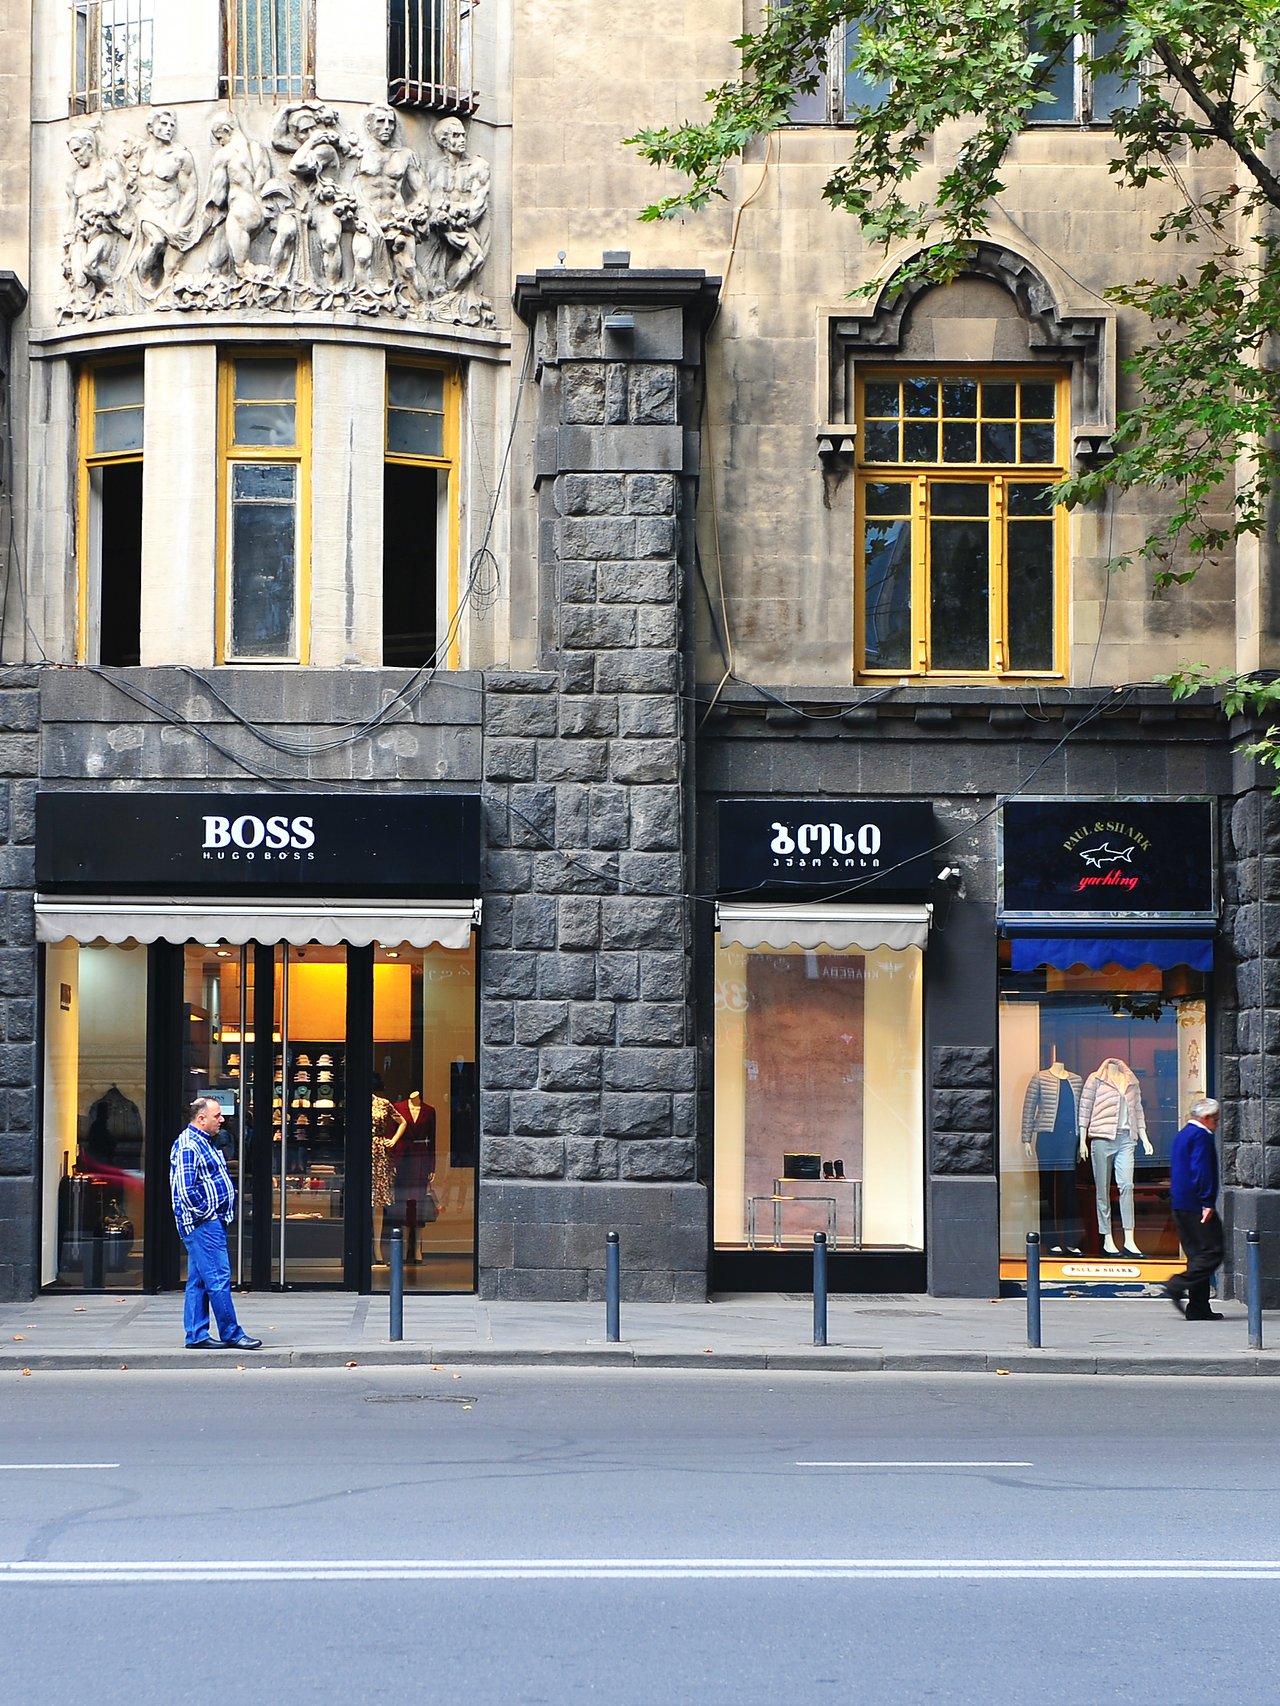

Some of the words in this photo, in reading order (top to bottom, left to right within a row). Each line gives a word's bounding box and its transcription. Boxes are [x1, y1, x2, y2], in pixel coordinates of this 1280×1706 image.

[201, 815, 316, 849] BOSS
[770, 822, 881, 855] ბოსი
[1062, 825, 1093, 852] PAUL
[1093, 821, 1105, 833] &
[1106, 821, 1153, 852] SHARK
[202, 851, 256, 860] HUGO
[264, 851, 316, 860] BOSS
[772, 858, 822, 867] ჰუგო
[832, 858, 880, 867] ბოსი
[1073, 869, 1140, 892] yachting
